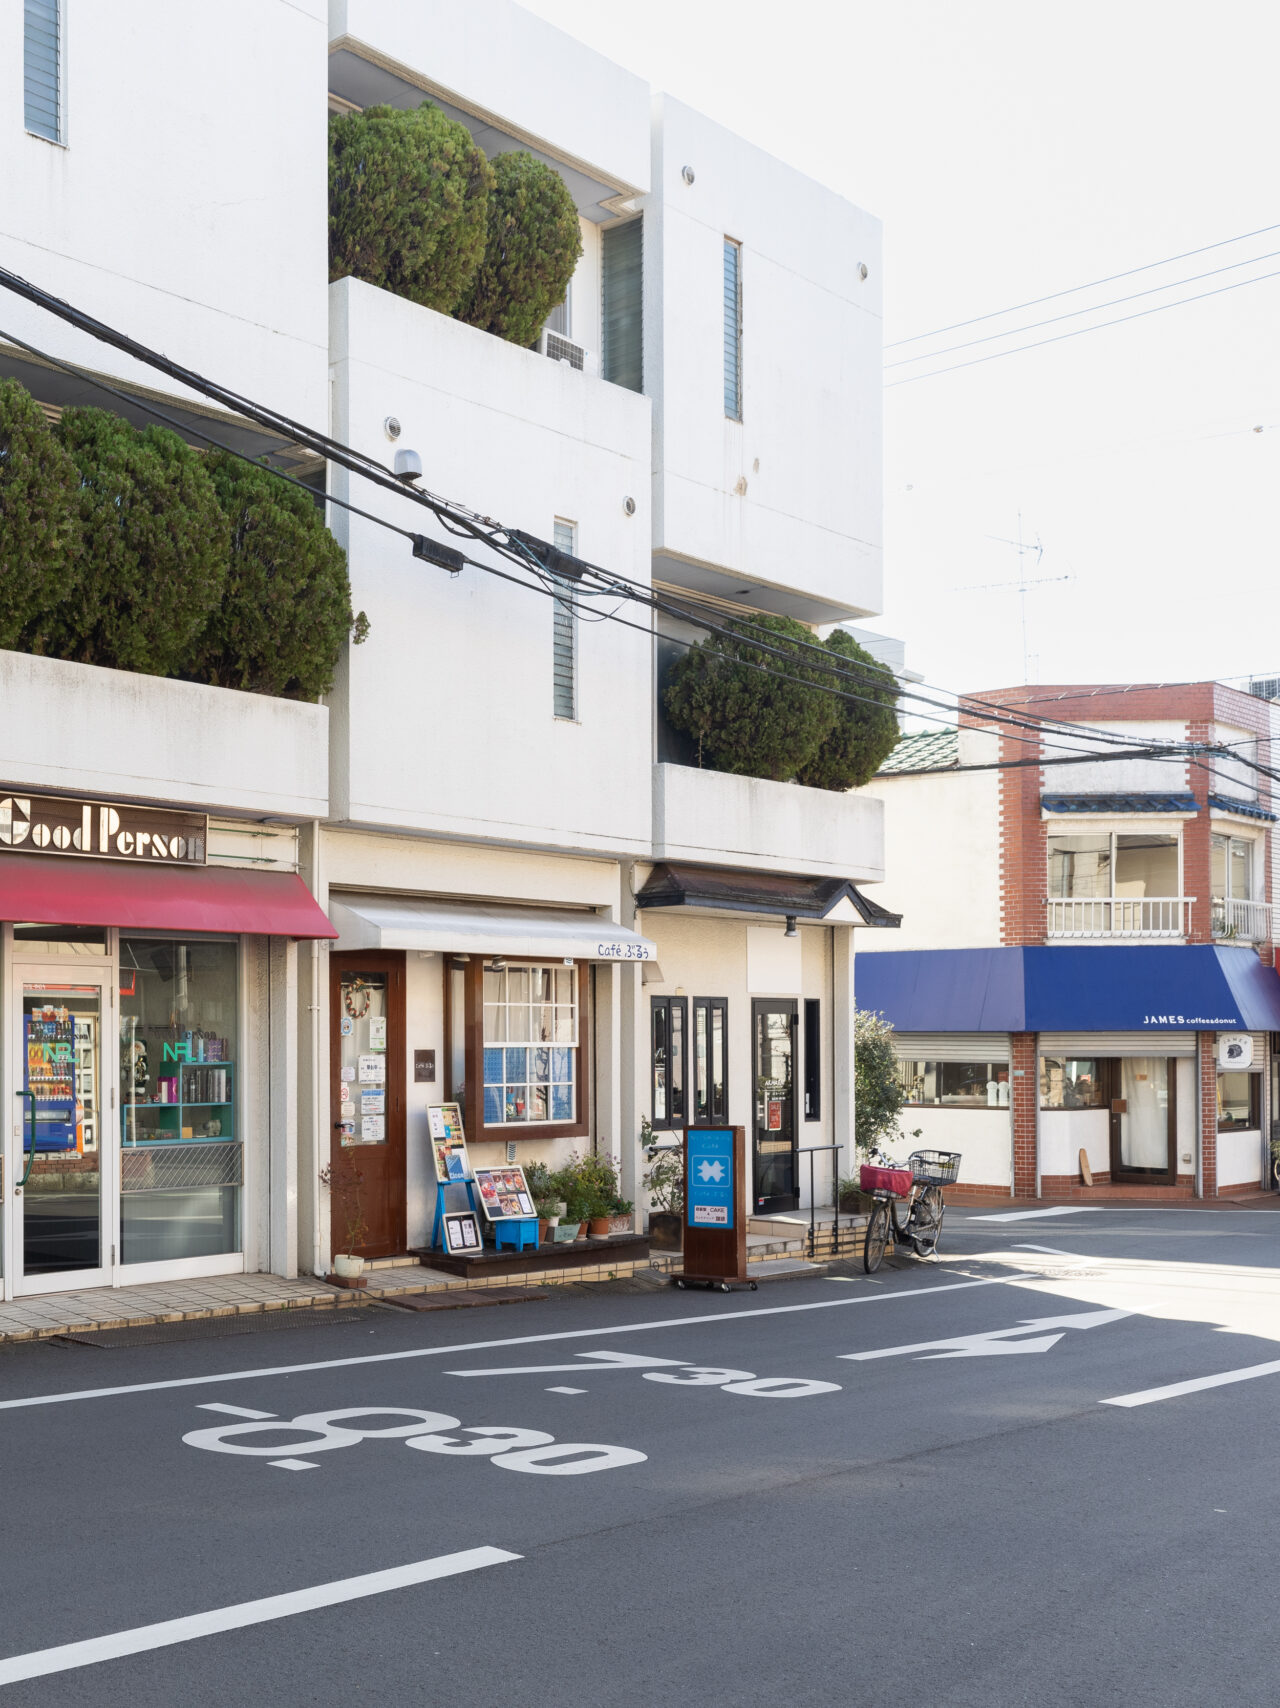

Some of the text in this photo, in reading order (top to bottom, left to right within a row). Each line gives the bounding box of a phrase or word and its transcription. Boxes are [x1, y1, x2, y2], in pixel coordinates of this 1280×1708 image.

[99, 806, 204, 860] Person
[598, 944, 621, 956] Café
[1144, 1016, 1185, 1024] JAMES
